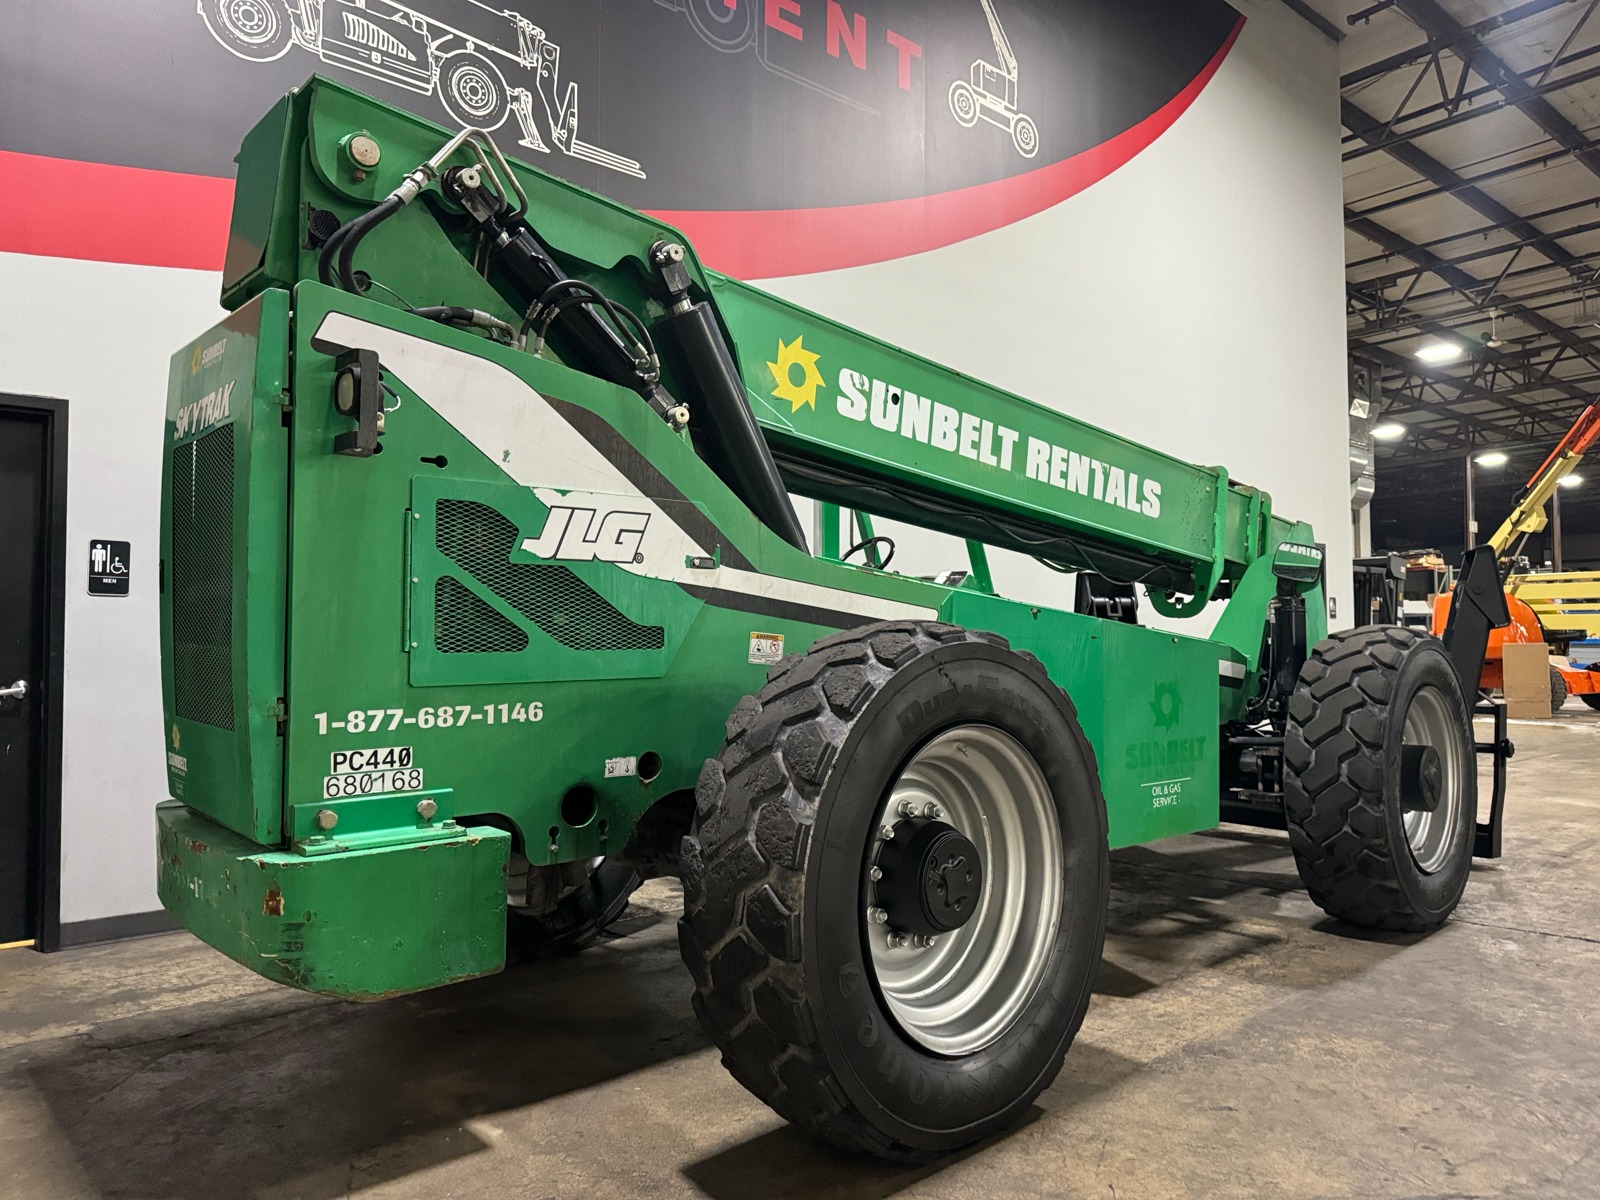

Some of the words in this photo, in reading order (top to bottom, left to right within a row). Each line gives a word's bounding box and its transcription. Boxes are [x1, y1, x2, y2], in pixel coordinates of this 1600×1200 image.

[724, 0, 922, 91] ENT
[173, 380, 236, 441] SKYTRAK
[836, 367, 1019, 472] SUNBELT
[1025, 436, 1162, 519] RENTALS
[314, 701, 544, 735] 1-877-687-1146
[333, 747, 411, 773] PC440
